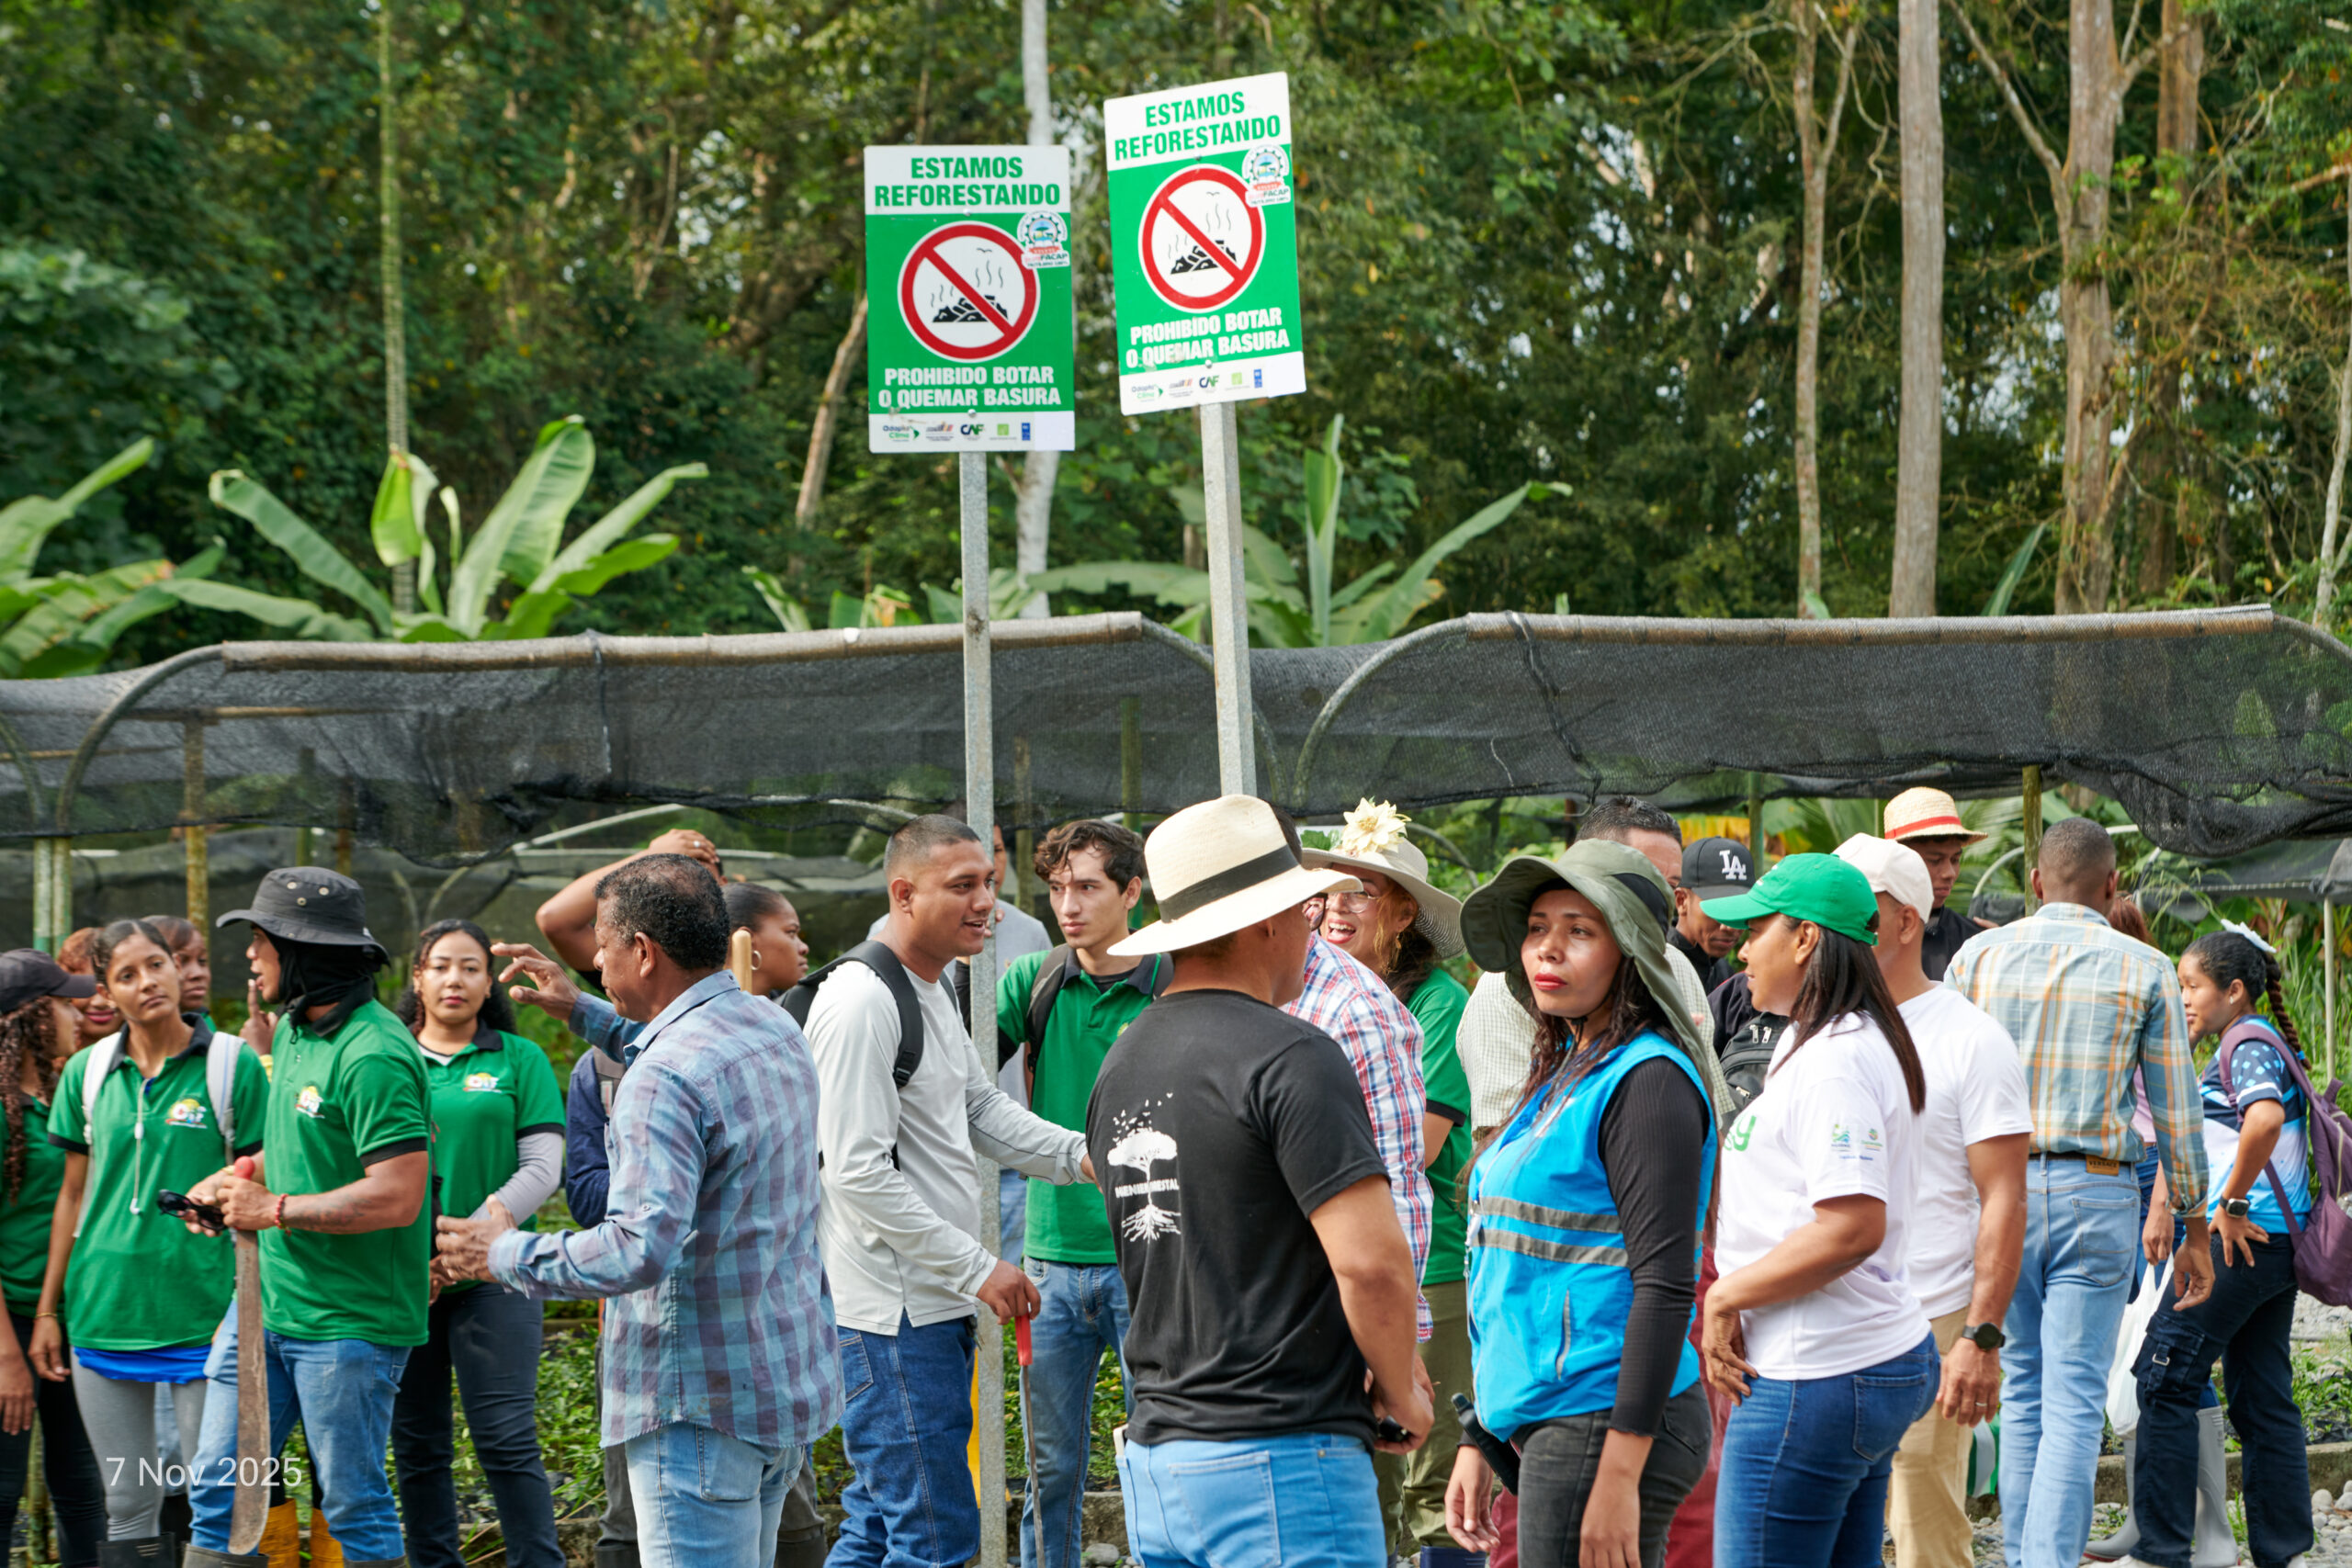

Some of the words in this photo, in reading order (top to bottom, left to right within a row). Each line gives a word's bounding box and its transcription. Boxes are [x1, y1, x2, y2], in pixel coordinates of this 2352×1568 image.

[1145, 91, 1245, 128] ESTAMOS
[1114, 115, 1281, 161] REFORESTANDO
[910, 156, 1023, 178] ESTAMOS
[874, 184, 1060, 207] REFORESTANDO
[1130, 315, 1221, 345] PROHIBIDO
[1225, 307, 1283, 333] BOTAR
[1125, 349, 1138, 368] O
[1142, 339, 1214, 367] QUEMAR
[1218, 329, 1290, 355] BASURA
[884, 367, 988, 386] PROHIBIDO
[992, 366, 1054, 385] BOTAR
[1199, 375, 1220, 389] CAF
[878, 389, 892, 408] O
[897, 389, 978, 410] QUEMAR
[984, 387, 1062, 406] BASURA
[960, 423, 985, 436] CAF
[1719, 850, 1747, 881] LA
